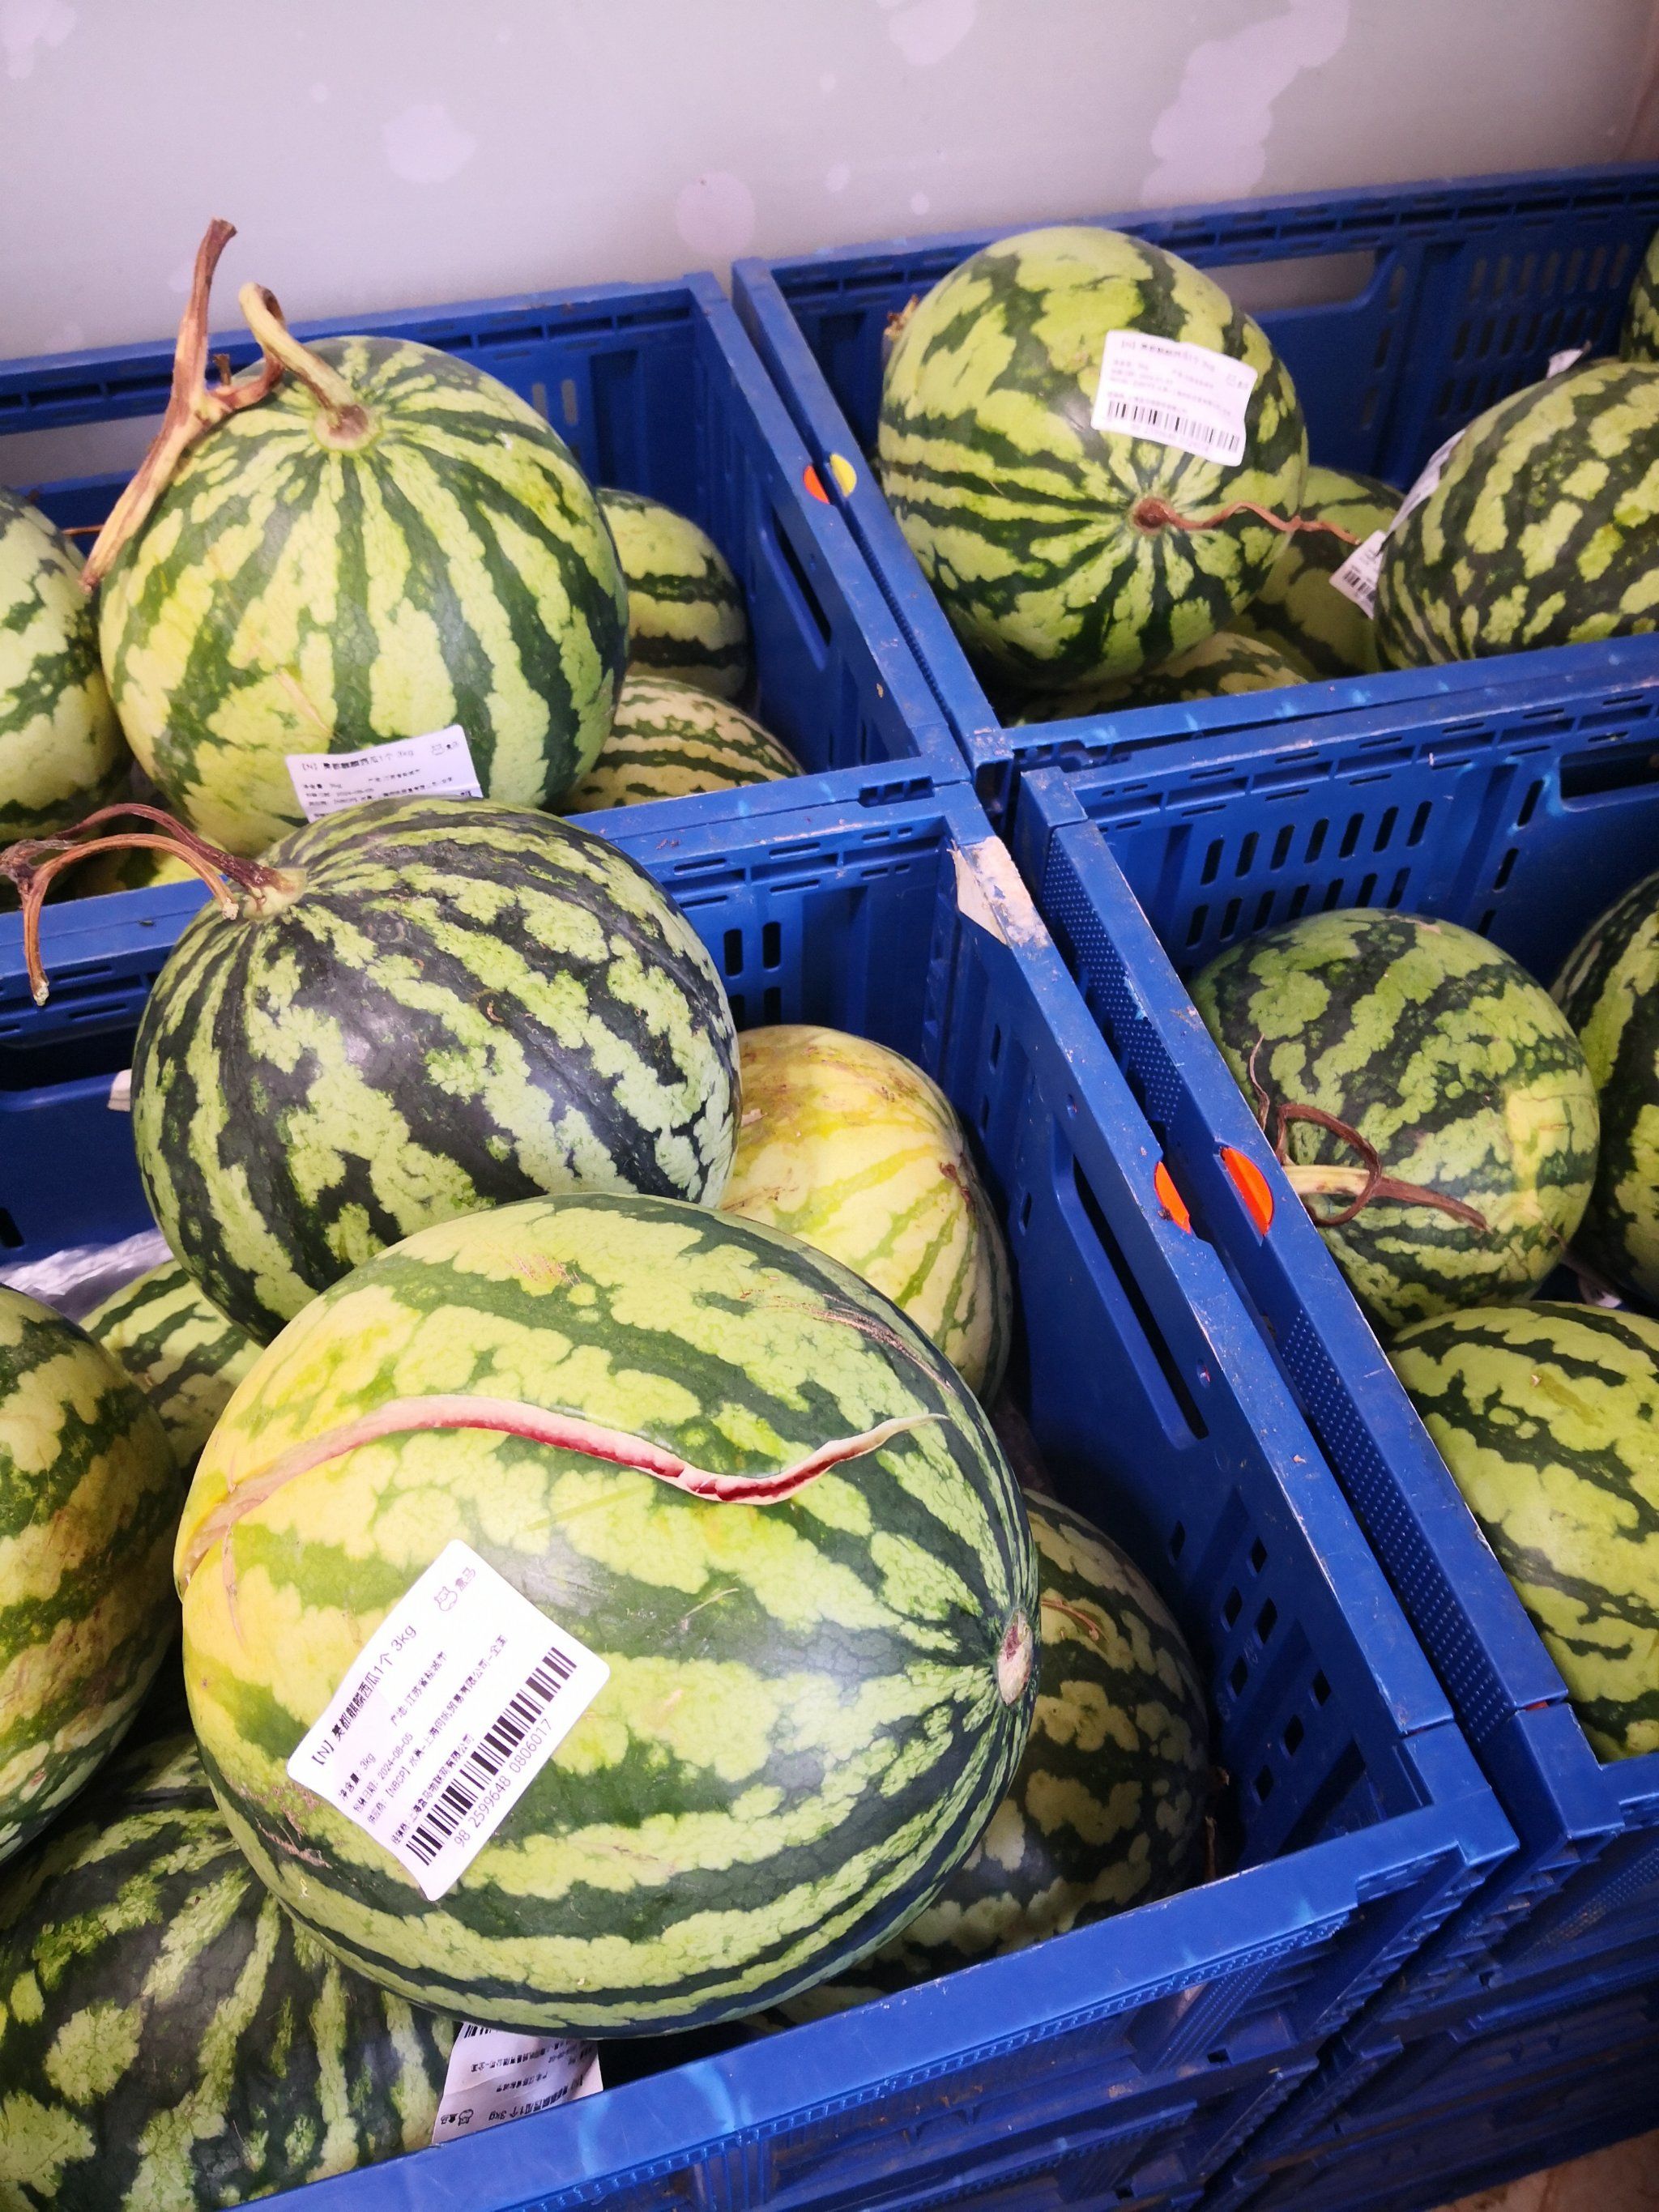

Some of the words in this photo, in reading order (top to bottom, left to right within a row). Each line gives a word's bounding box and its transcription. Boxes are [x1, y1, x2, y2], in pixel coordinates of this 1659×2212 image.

[455, 1567, 476, 1592] 盒马
[391, 1623, 417, 1652] 3kg
[454, 1829, 471, 1848] 98
[470, 1775, 511, 1828] 2599648
[510, 1718, 552, 1774] 0806017
